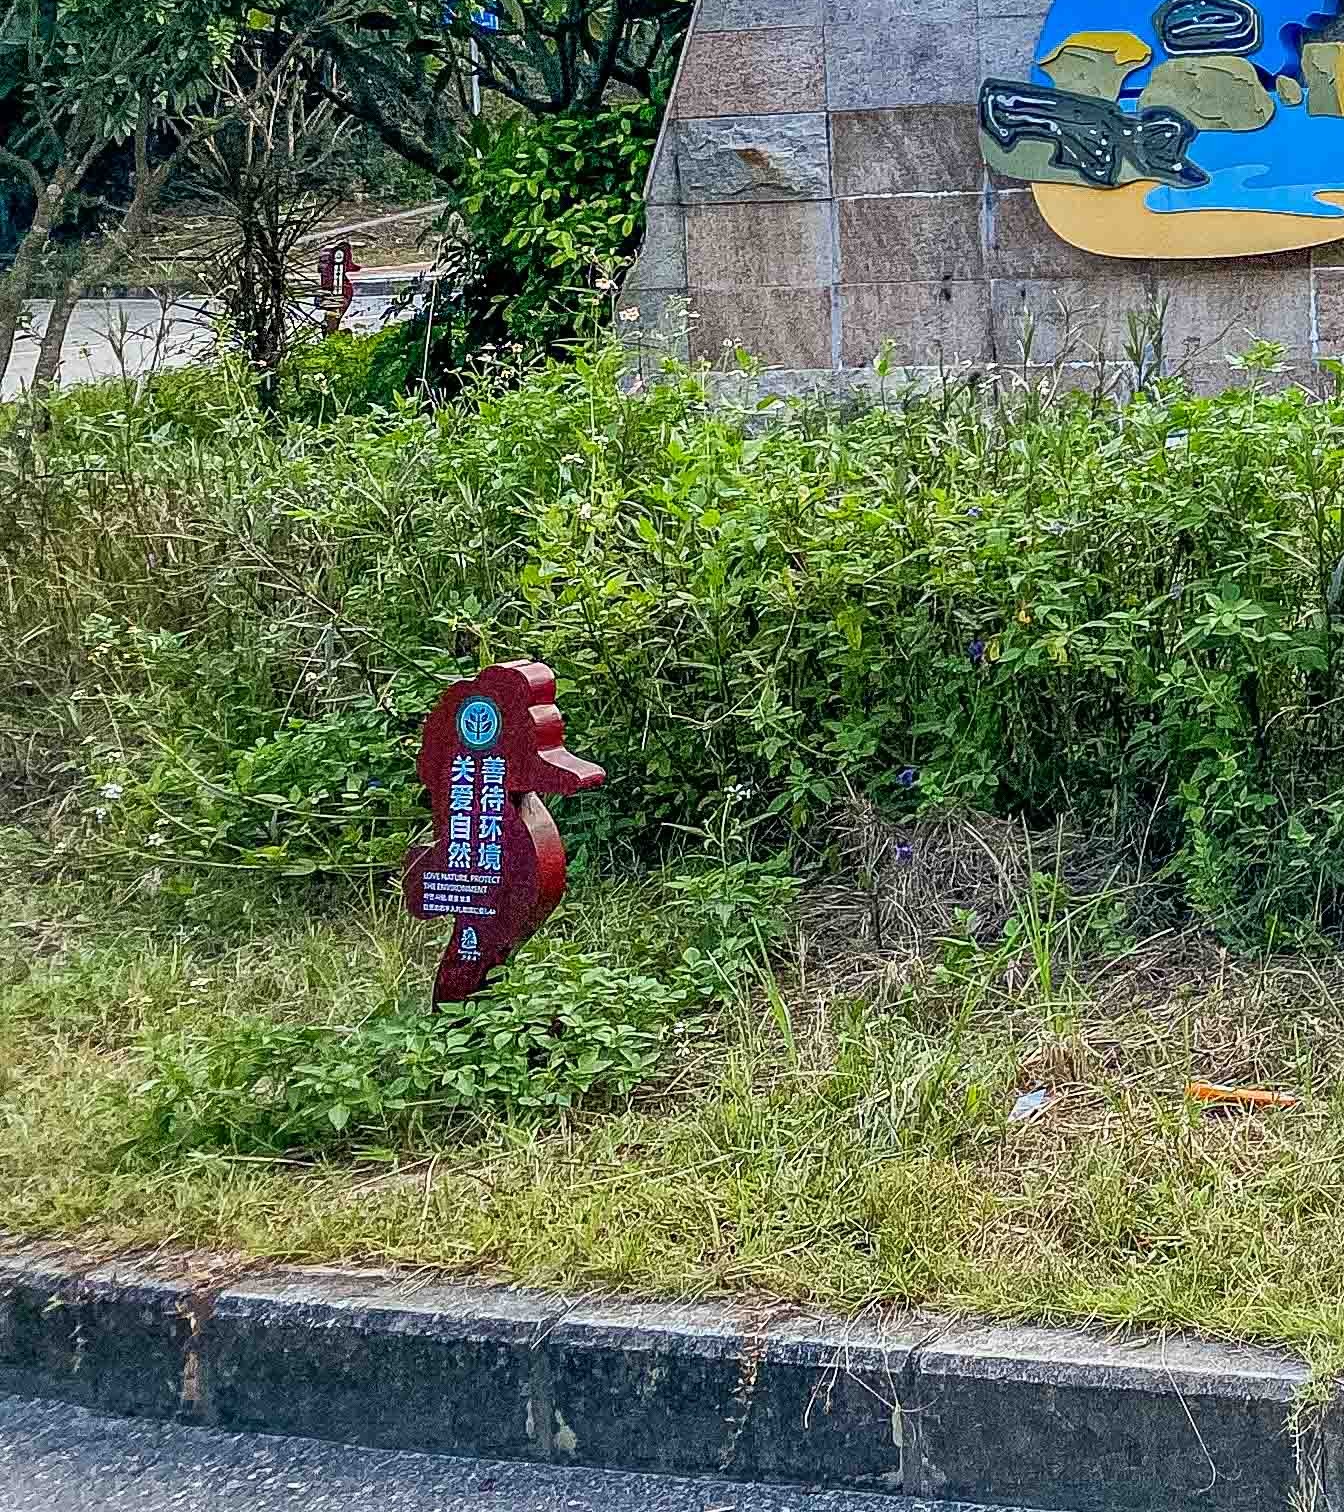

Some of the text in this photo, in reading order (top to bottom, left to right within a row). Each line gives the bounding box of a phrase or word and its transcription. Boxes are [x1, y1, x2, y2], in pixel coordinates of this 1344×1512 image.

[448, 756, 475, 868] 关爱自然
[478, 756, 505, 870] 善待环境
[423, 872, 439, 880] LOVE
[470, 874, 500, 883] PROTECT
